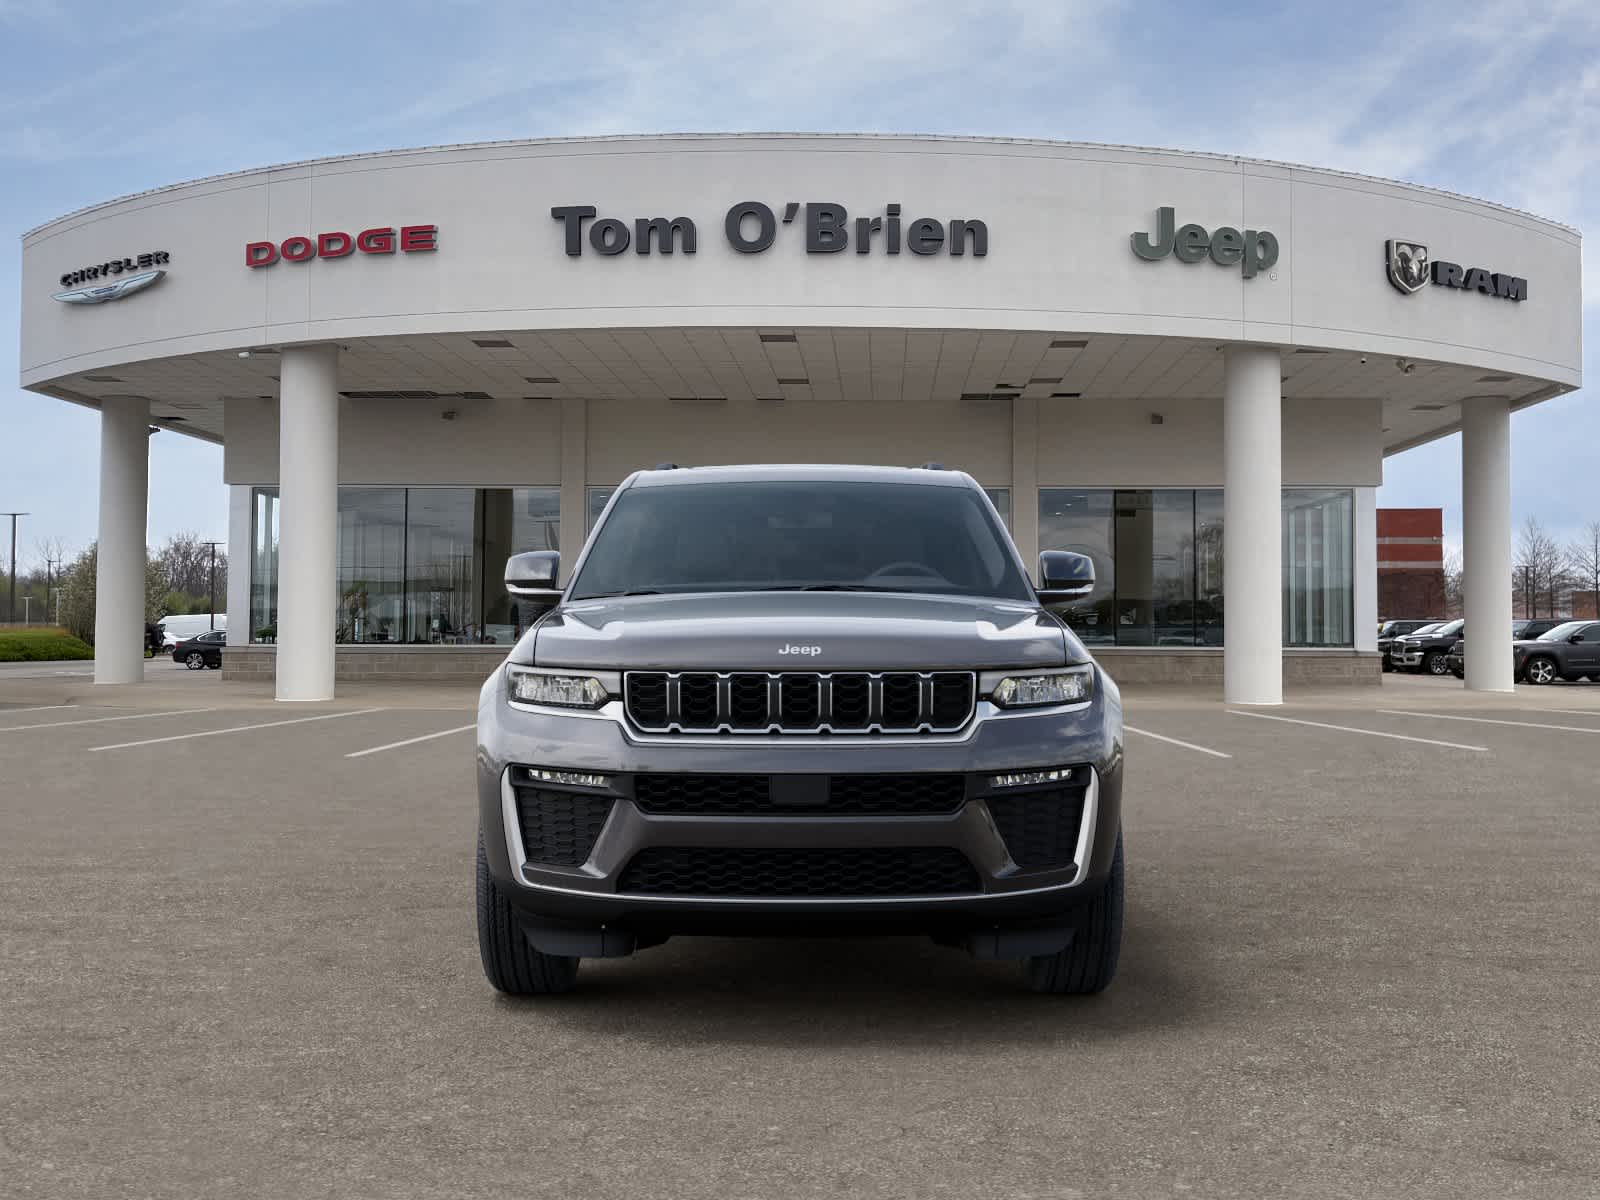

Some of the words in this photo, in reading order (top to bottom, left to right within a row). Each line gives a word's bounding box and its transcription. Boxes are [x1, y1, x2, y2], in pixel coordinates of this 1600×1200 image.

[245, 224, 438, 269] DODGE
[551, 205, 697, 256] Tom
[1130, 206, 1280, 280] Jeep
[60, 250, 170, 287] CHRYSLER
[1430, 260, 1528, 302] RAM
[778, 643, 822, 656] Jeep
